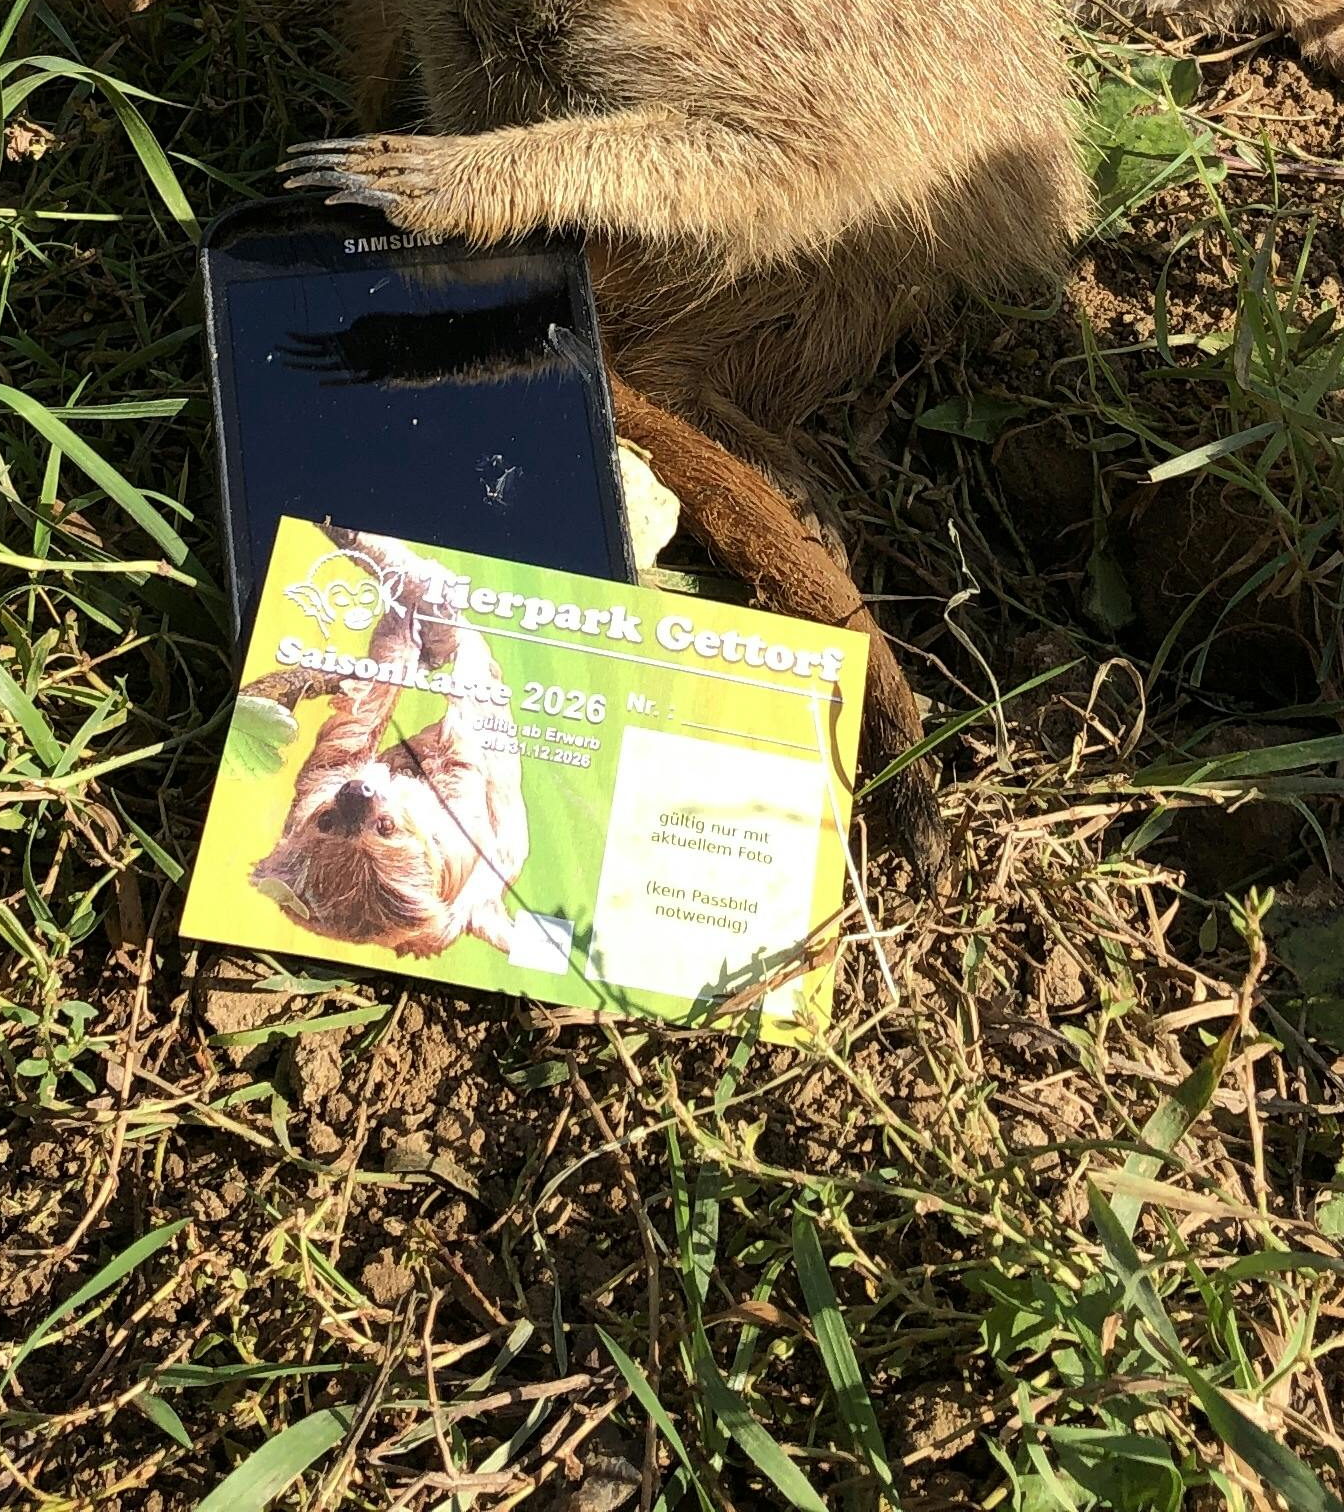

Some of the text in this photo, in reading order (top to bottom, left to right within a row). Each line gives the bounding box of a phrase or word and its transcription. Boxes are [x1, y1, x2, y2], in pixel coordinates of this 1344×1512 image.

[423, 573, 845, 682] Tierpark Gettorf
[275, 636, 607, 725] Saisonkarte 2026
[521, 720, 543, 739] ab
[545, 726, 601, 751] Erwerb
[508, 740, 592, 769] 31.12.2026
[659, 811, 770, 844] gültig nur mit
[651, 830, 773, 865] aktuellem Foto
[646, 880, 759, 914] (kein Passbild
[655, 904, 748, 935] notwendig)
